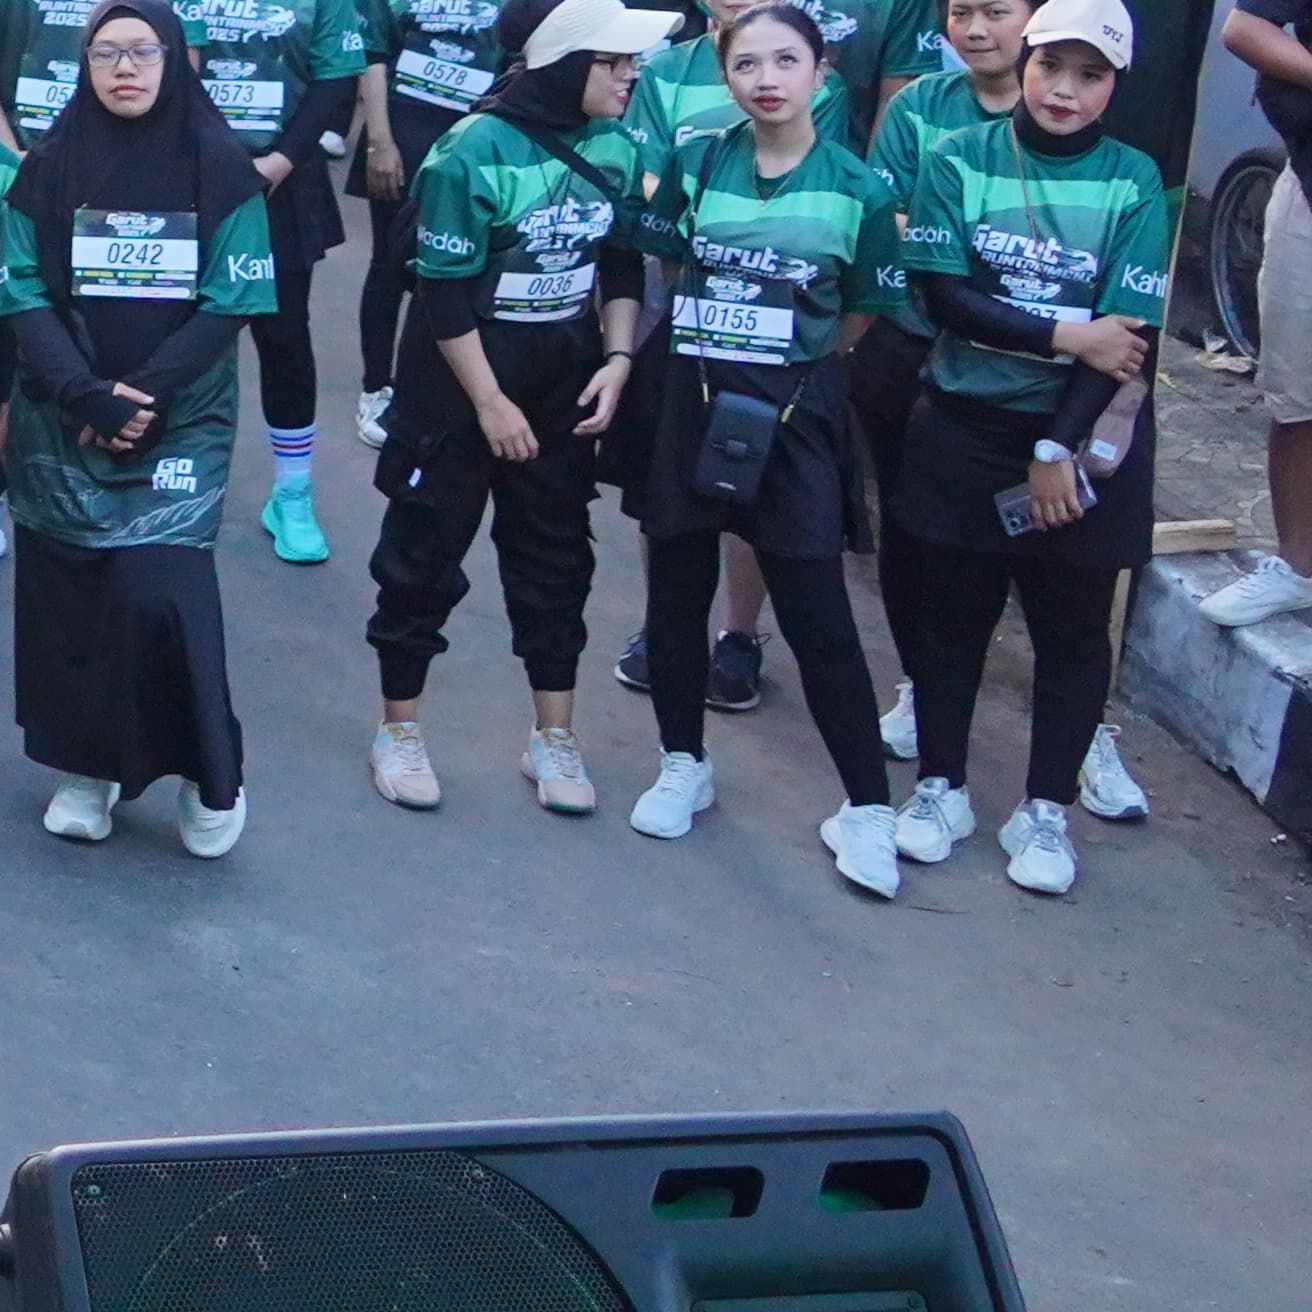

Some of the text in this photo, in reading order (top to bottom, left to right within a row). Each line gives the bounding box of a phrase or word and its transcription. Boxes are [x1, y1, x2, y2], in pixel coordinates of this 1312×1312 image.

[43, 10, 89, 28] 2025
[207, 26, 240, 42] 025
[423, 60, 468, 86] 0578
[208, 83, 255, 105] 0573
[105, 212, 152, 229] Garut
[107, 241, 164, 266] 0242
[692, 235, 780, 273] Garut
[972, 223, 1064, 264] Garut
[527, 274, 573, 297] 0036
[705, 275, 739, 292] Garut
[1000, 273, 1047, 292] Garut
[704, 304, 758, 332] 0155
[155, 456, 194, 476] Go
[151, 472, 198, 495] Run
